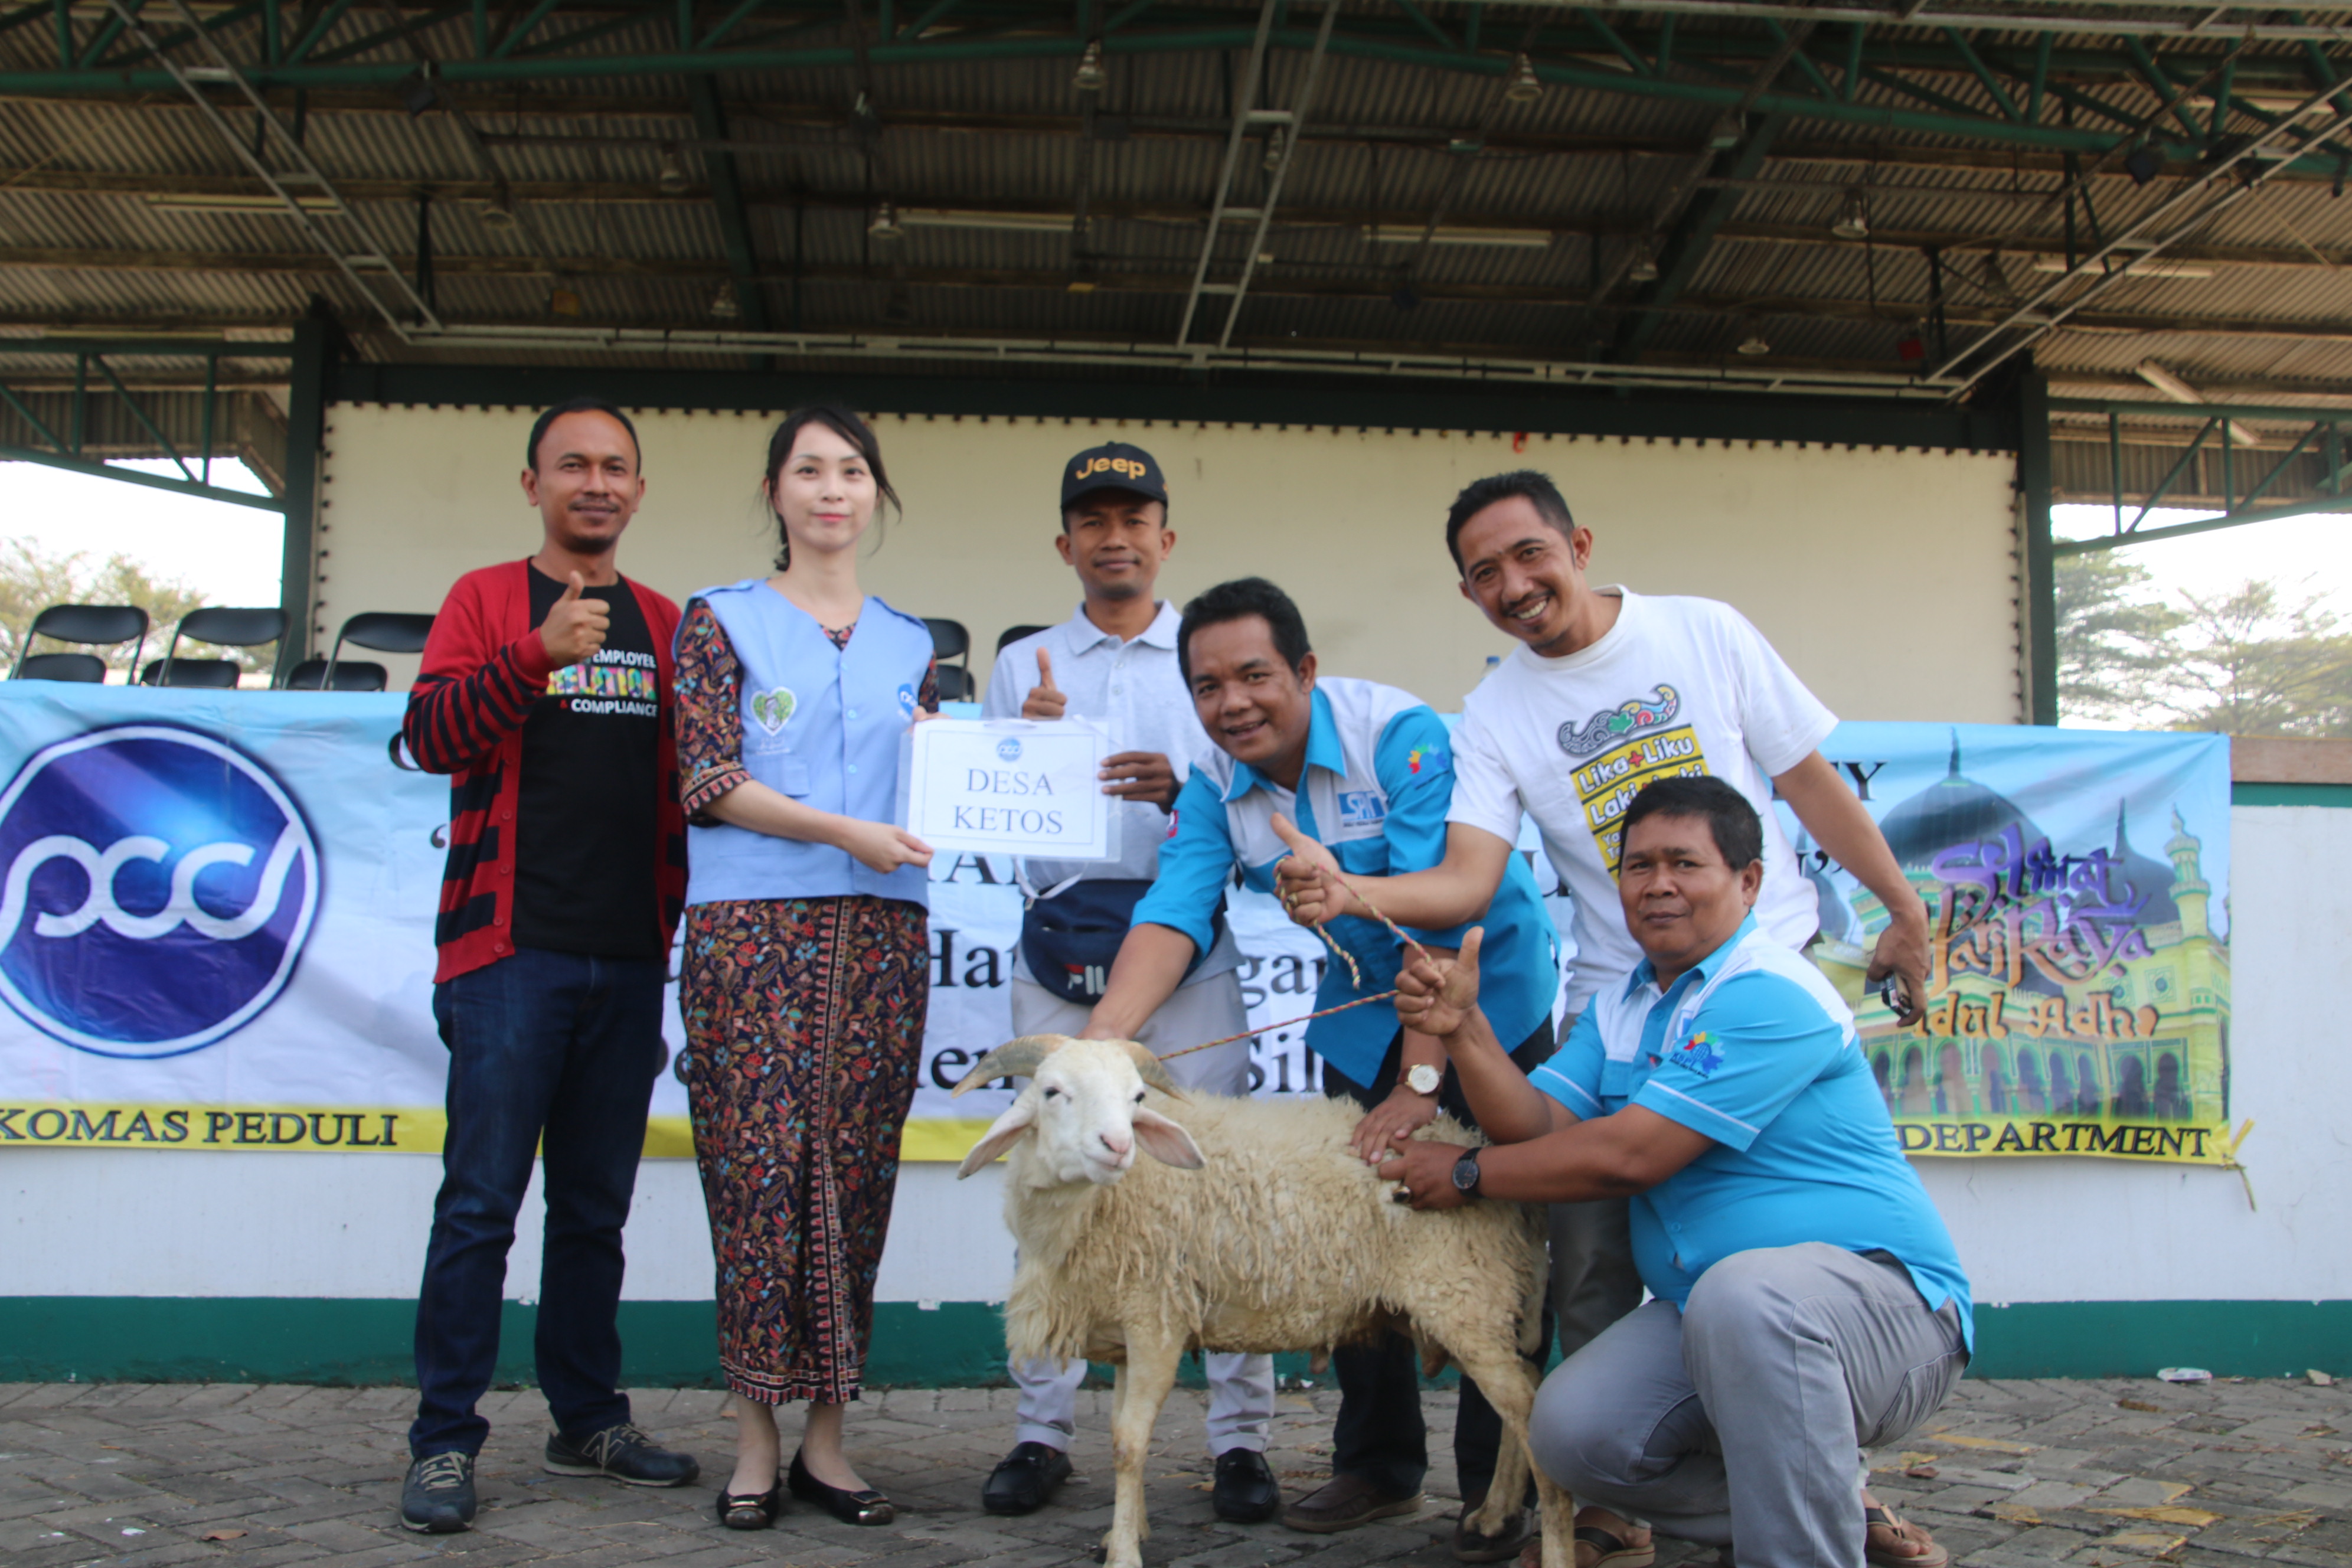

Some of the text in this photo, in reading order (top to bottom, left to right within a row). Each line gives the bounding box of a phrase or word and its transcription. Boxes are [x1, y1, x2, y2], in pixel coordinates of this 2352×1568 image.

[1076, 457, 1146, 479] Jeep
[571, 698, 658, 717] COMPLIANCE
[967, 768, 1054, 795] DESA
[954, 805, 1063, 834] KETOS
[202, 1111, 399, 1146] PEDULI
[1894, 1121, 2211, 1157] DEPARTMENT
